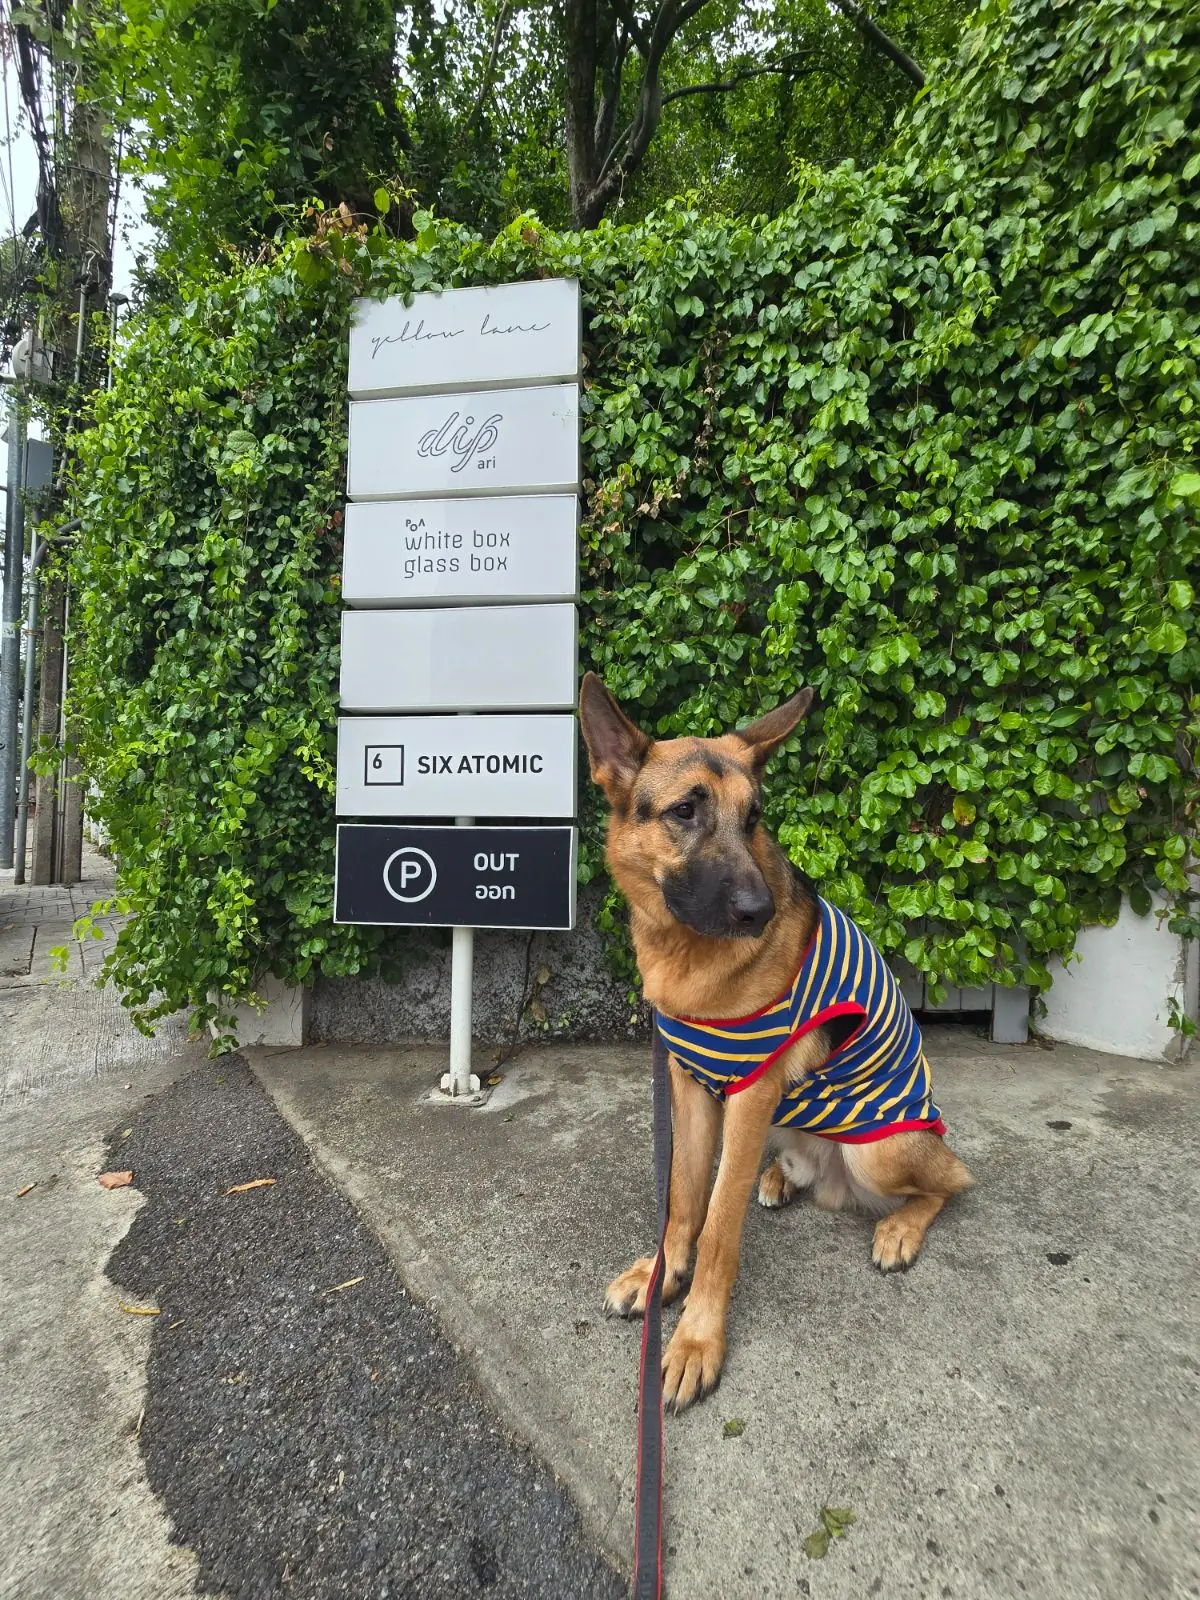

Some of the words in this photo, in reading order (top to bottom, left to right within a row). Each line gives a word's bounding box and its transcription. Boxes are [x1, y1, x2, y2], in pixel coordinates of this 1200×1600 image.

[371, 319, 465, 360] yellow
[480, 313, 552, 336] lane
[416, 411, 504, 474] dip
[477, 455, 496, 470] ari
[404, 530, 463, 551] white
[473, 529, 511, 548] box
[403, 554, 460, 579] glass
[470, 553, 508, 572] box
[372, 752, 383, 770] 6
[473, 852, 520, 872] OUT
[400, 860, 422, 889] P
[474, 884, 516, 900] ออก
